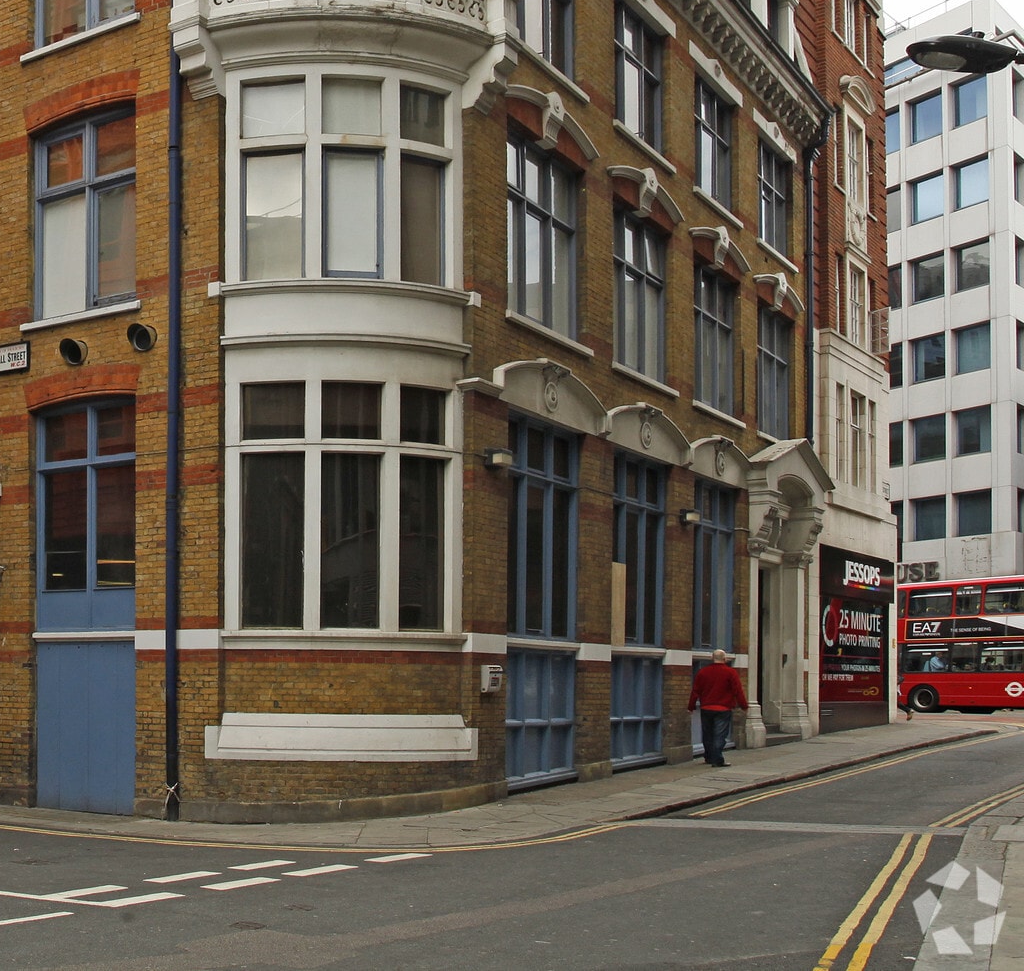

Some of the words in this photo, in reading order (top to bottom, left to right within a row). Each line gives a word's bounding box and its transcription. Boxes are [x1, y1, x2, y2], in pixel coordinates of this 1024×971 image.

[7, 351, 26, 362] STREET
[843, 560, 881, 587] JESSOPS
[839, 609, 849, 629] 25
[851, 611, 881, 633] MINUTE
[913, 621, 942, 633] EA7
[839, 633, 857, 647] PHOTO
[858, 635, 881, 649] PRINTING
